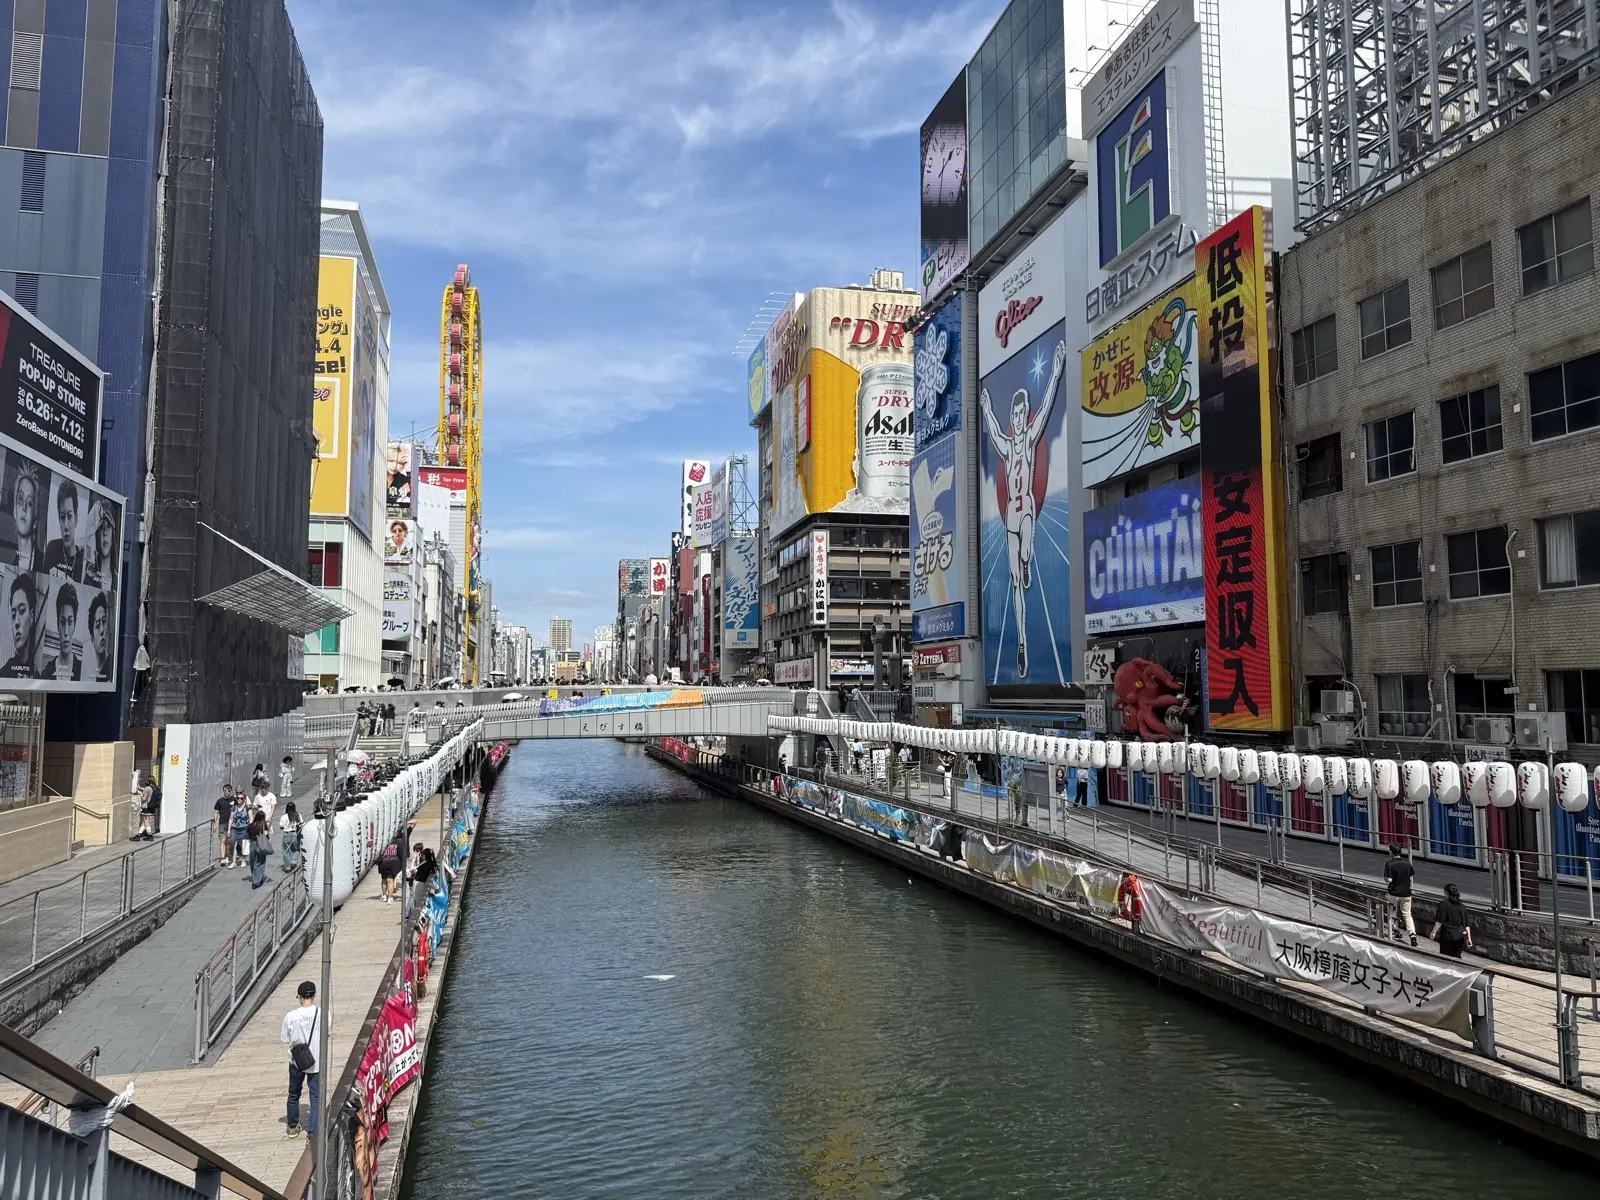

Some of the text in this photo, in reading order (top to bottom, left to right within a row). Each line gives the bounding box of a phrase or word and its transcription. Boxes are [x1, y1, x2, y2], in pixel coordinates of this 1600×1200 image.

[1097, 24, 1172, 117] エステムシリーズ
[1104, 11, 1161, 83] 夢ある住まい
[1085, 223, 1198, 325] 日商エステム
[995, 295, 1044, 348] Glico
[30, 342, 81, 393] TREASURE
[1093, 336, 1132, 371] かぜに
[19, 357, 86, 416] POP-UP STORE
[884, 388, 908, 396] SUPER
[1089, 353, 1136, 409] 改源
[16, 412, 84, 460] ZeroBase DOTONBORI
[61, 413, 81, 441] 7.12
[888, 439, 904, 451] 生
[1013, 454, 1024, 513] グリコ
[913, 531, 954, 579] さける
[815, 578, 826, 622] かに道楽
[913, 576, 929, 599] チーズ
[382, 619, 410, 633] グループ
[582, 722, 644, 732] えびす橋
[1467, 749, 1487, 760] BAR
[1274, 938, 1434, 1008] 大阪樟蔭女子大学
